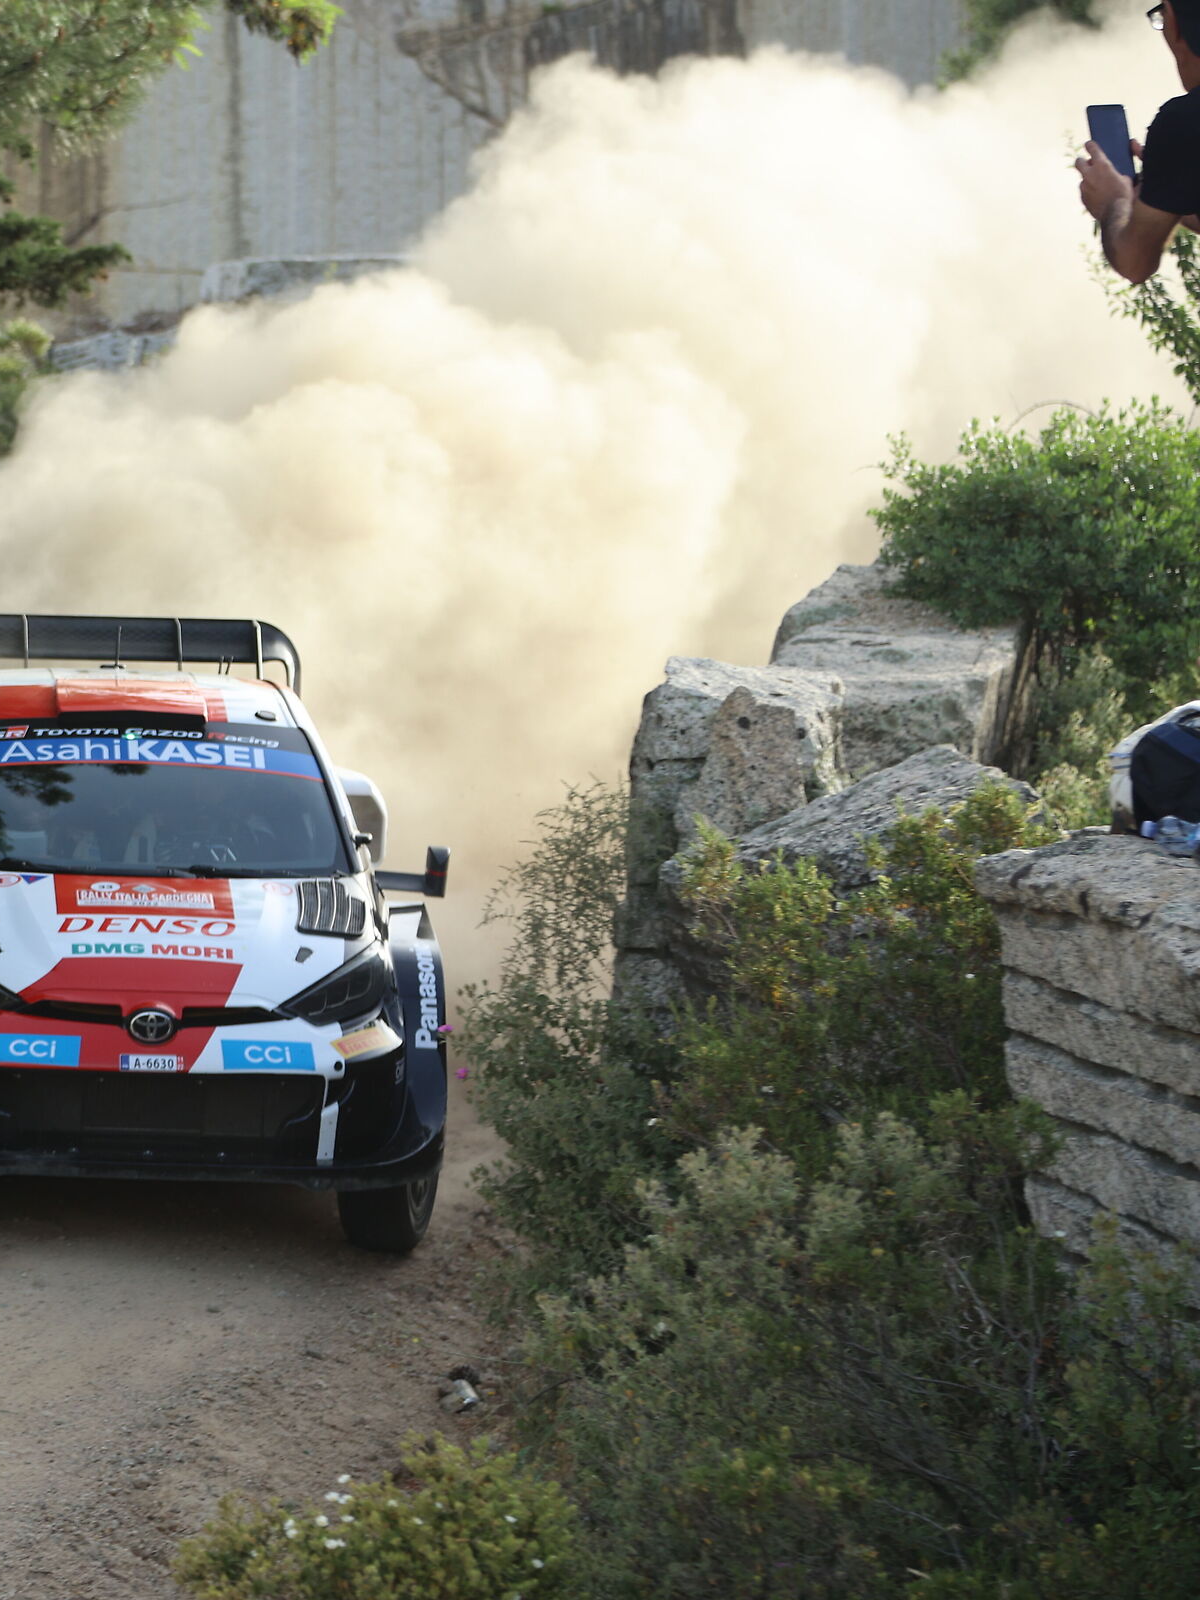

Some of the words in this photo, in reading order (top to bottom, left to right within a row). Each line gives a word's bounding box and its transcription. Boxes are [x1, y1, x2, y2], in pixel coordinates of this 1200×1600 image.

[32, 727, 119, 737] TOYOTA
[125, 727, 203, 739] GAZOO
[208, 731, 280, 749] Racing
[80, 889, 113, 902] RALLY
[114, 891, 150, 903] ITALIA
[151, 892, 210, 905] SARDEGNA
[58, 917, 236, 937] DENSO
[71, 943, 145, 955] DMG
[151, 944, 234, 960] MORI
[134, 1057, 174, 1070] A-6630
